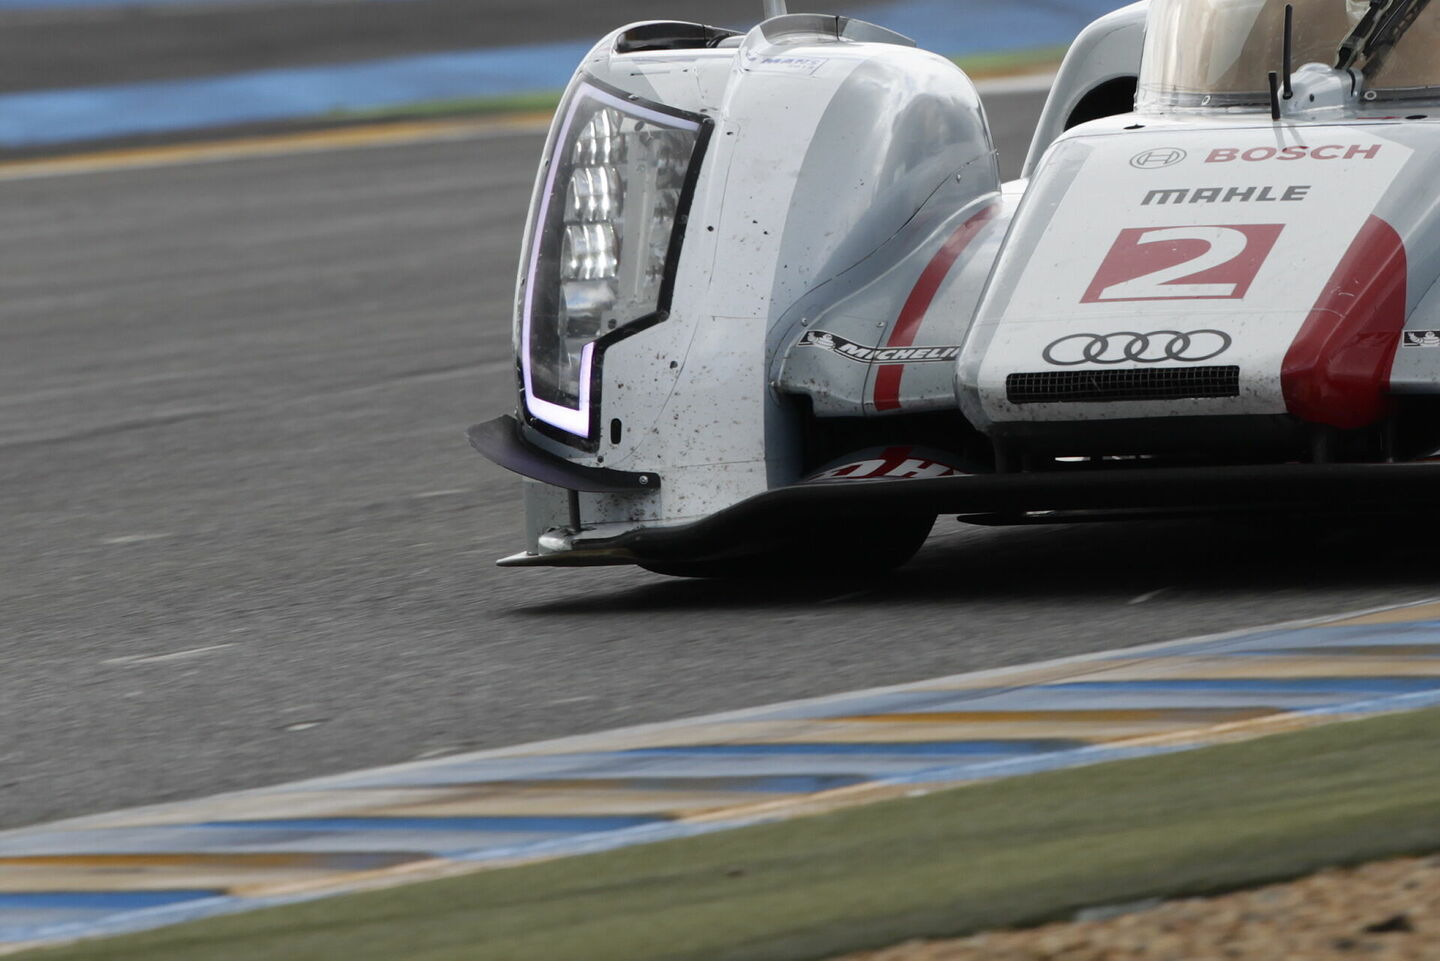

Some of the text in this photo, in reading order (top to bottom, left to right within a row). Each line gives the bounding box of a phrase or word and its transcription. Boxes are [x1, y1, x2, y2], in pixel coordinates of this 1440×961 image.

[1204, 142, 1383, 164] BOSCH
[1140, 184, 1312, 206] MAHLE
[1098, 225, 1248, 301] 2
